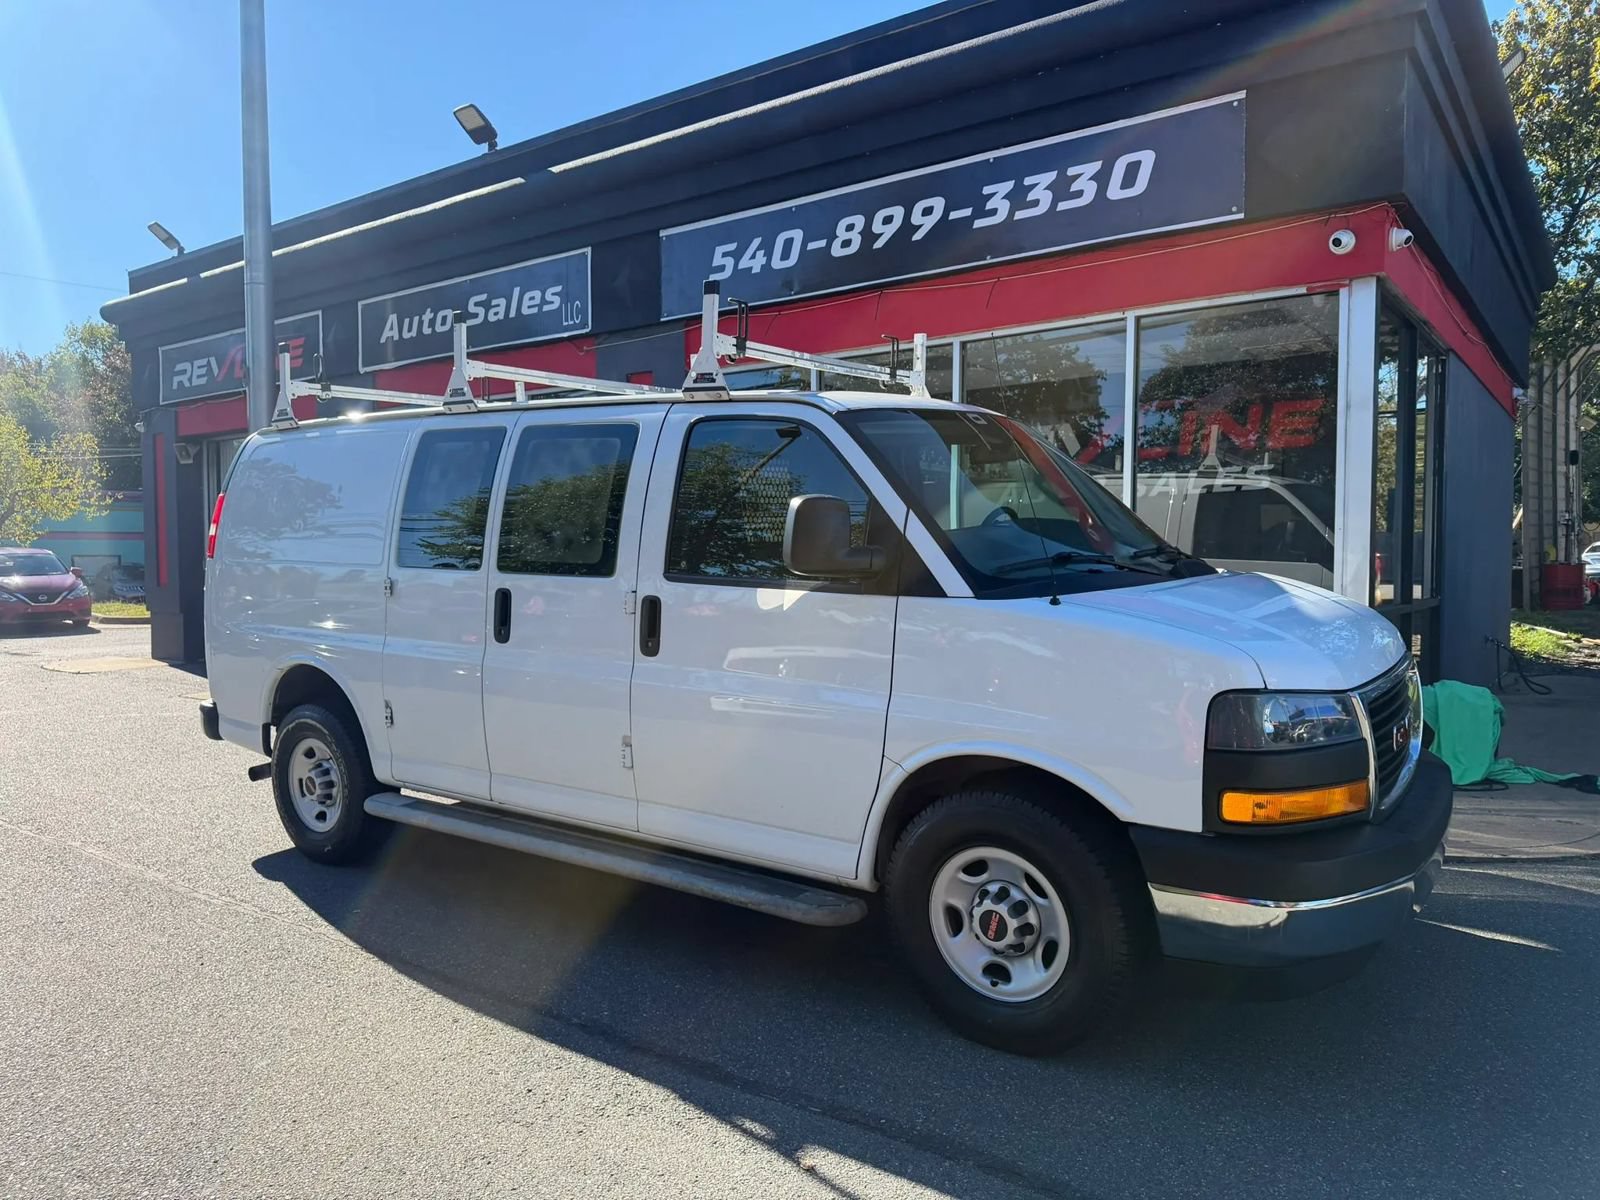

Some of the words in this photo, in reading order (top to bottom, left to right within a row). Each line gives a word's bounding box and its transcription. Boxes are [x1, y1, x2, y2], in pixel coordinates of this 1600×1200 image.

[707, 148, 1157, 281] 540-899-3330
[380, 307, 454, 344] Auto
[465, 284, 563, 327] Sales
[562, 300, 582, 326] LLC
